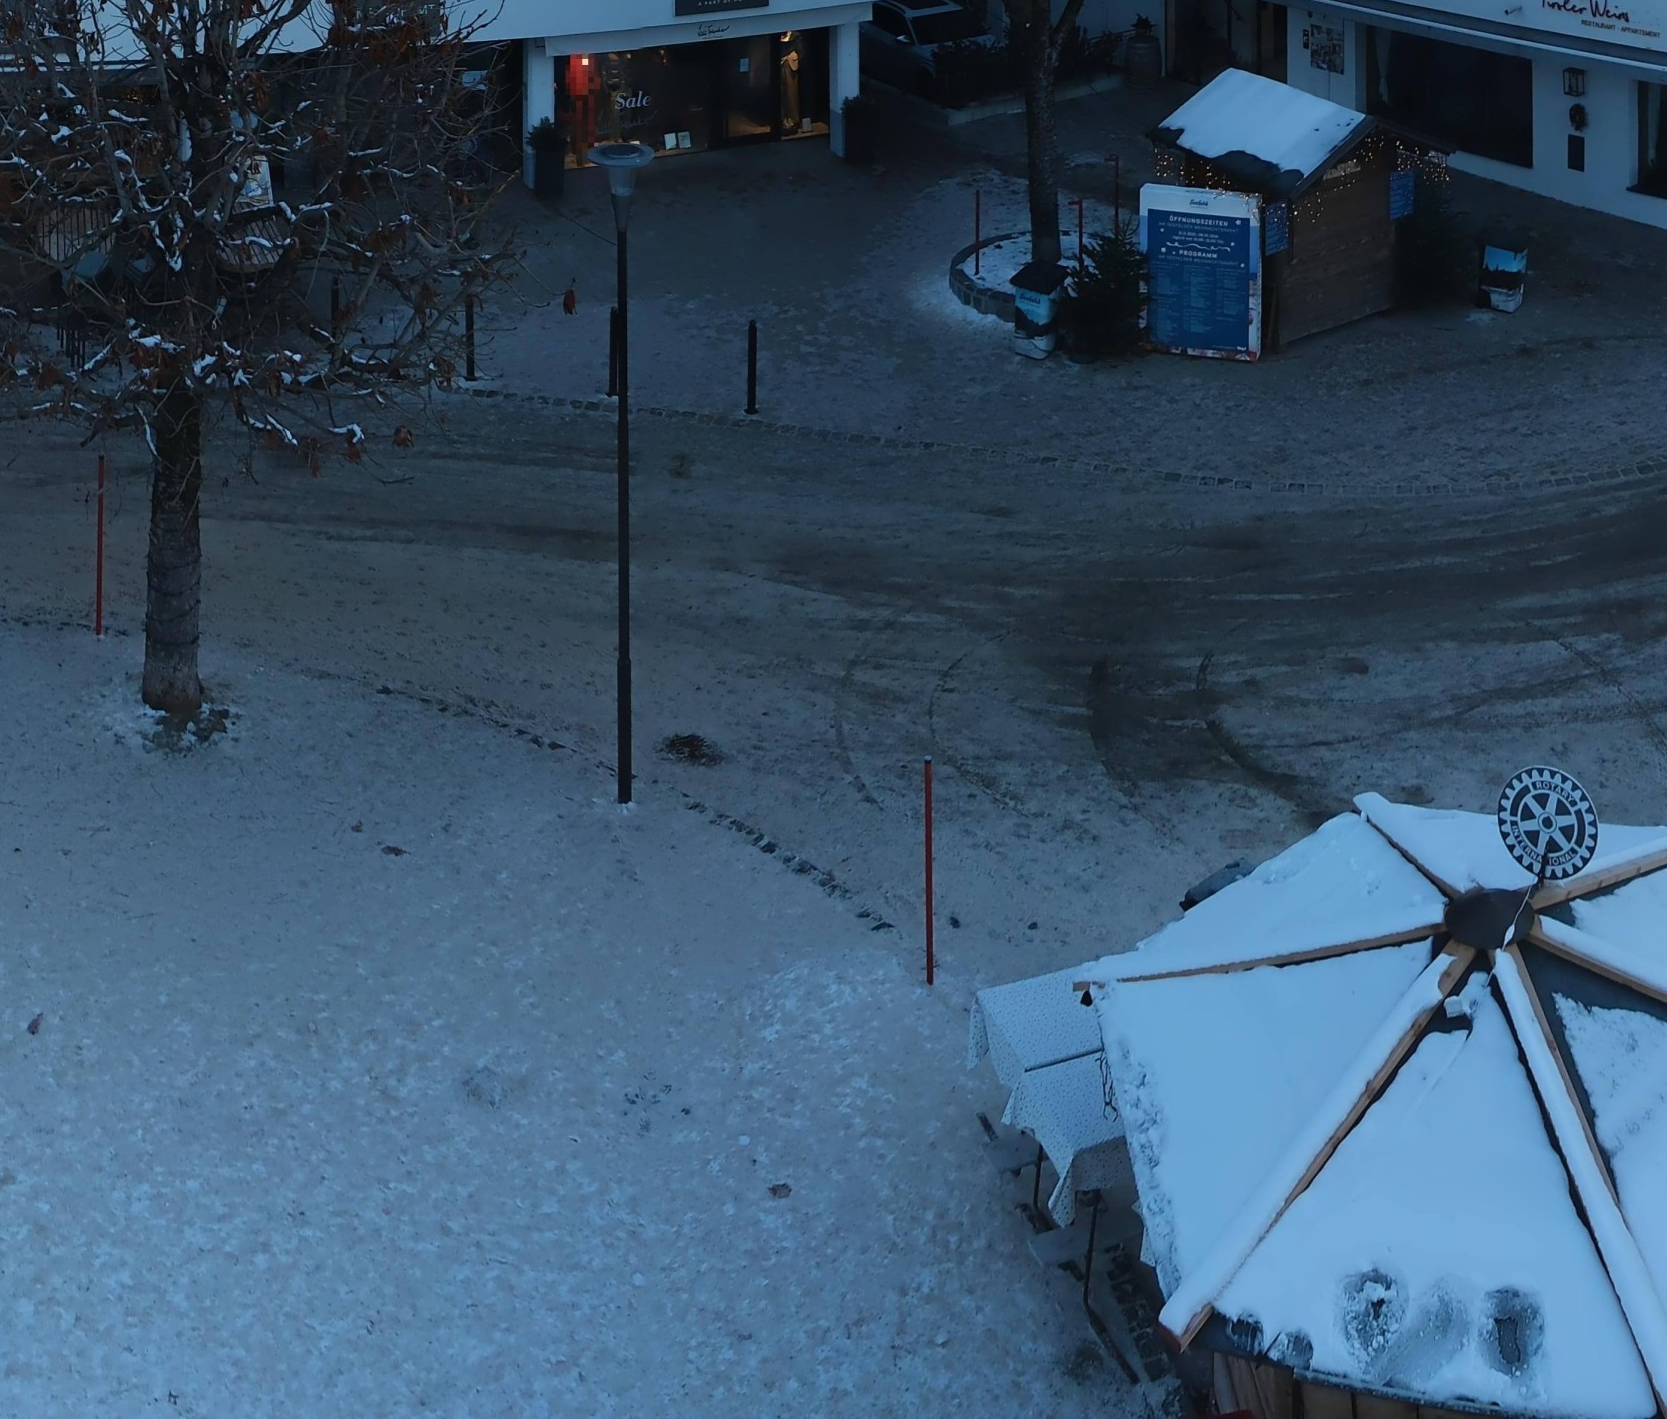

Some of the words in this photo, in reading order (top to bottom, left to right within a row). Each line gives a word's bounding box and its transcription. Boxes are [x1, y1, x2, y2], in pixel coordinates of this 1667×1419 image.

[1580, 19, 1616, 31] RESTAURANT
[614, 90, 652, 110] Sale
[1168, 214, 1229, 227] ÖFFNUNGSZEITEN
[1178, 249, 1218, 259] PROGRAMM
[1535, 780, 1576, 802] ROTARY
[1511, 824, 1576, 866] INTERNAIONAL
